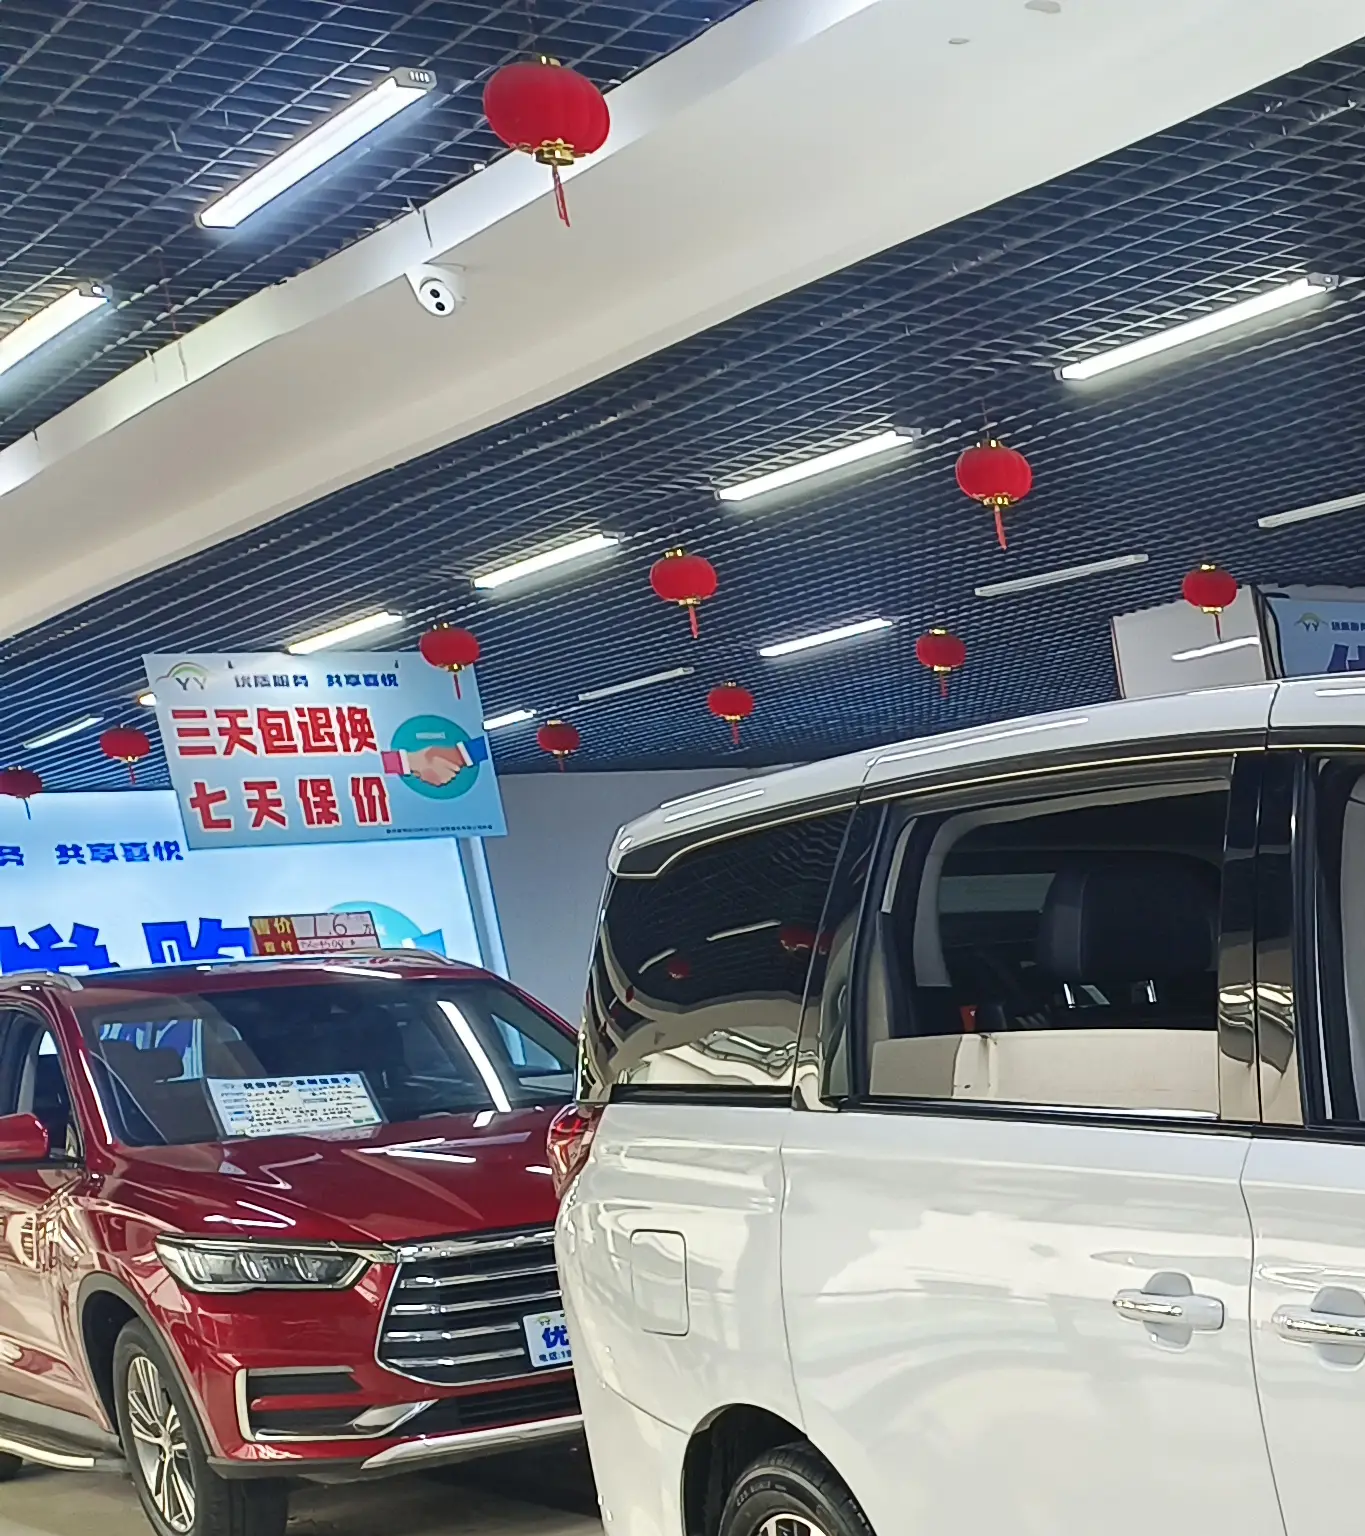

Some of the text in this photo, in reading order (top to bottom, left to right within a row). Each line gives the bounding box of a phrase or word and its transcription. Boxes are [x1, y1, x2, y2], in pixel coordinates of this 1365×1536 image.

[171, 706, 379, 758] 三天包退换
[188, 775, 392, 831] 七天保价
